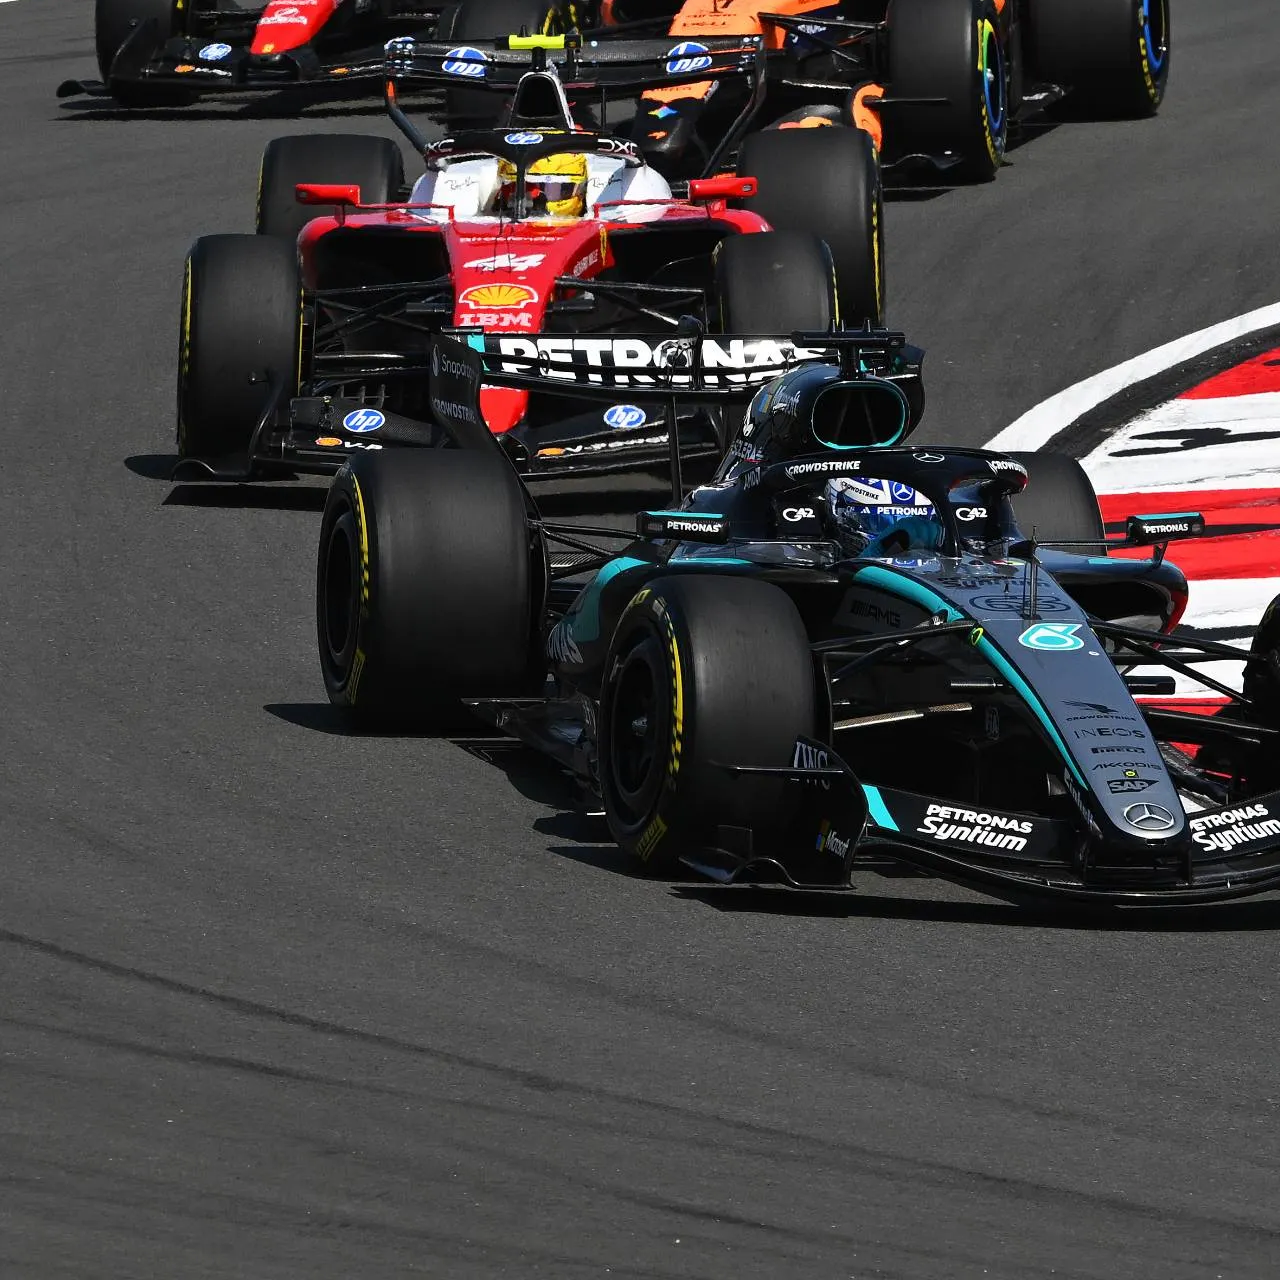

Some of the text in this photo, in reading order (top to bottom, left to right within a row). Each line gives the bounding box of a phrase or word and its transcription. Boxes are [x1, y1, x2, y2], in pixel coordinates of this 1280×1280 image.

[463, 253, 547, 272] 44
[459, 312, 533, 327] IBM
[349, 410, 380, 432] hp
[608, 405, 642, 428] hp
[788, 460, 861, 475] CROWDSTRIKE
[840, 480, 880, 501] CROWDSTRIKE
[783, 507, 816, 522] G42
[877, 506, 928, 516] PETRONAS
[955, 507, 988, 521] G42
[667, 520, 721, 533] PETRONAS
[1144, 523, 1189, 534] PETRONAS
[868, 603, 902, 628] AMG
[1066, 714, 1137, 722] CROWDSTRIKE
[1074, 727, 1146, 740] INEOS
[1091, 746, 1146, 754] PIRELLI
[1092, 761, 1162, 771] AKKODIS
[1108, 780, 1148, 792] SAP
[926, 804, 1033, 833] PETRONAS
[917, 816, 1028, 852] Syntium
[825, 829, 851, 859] Microsoft
